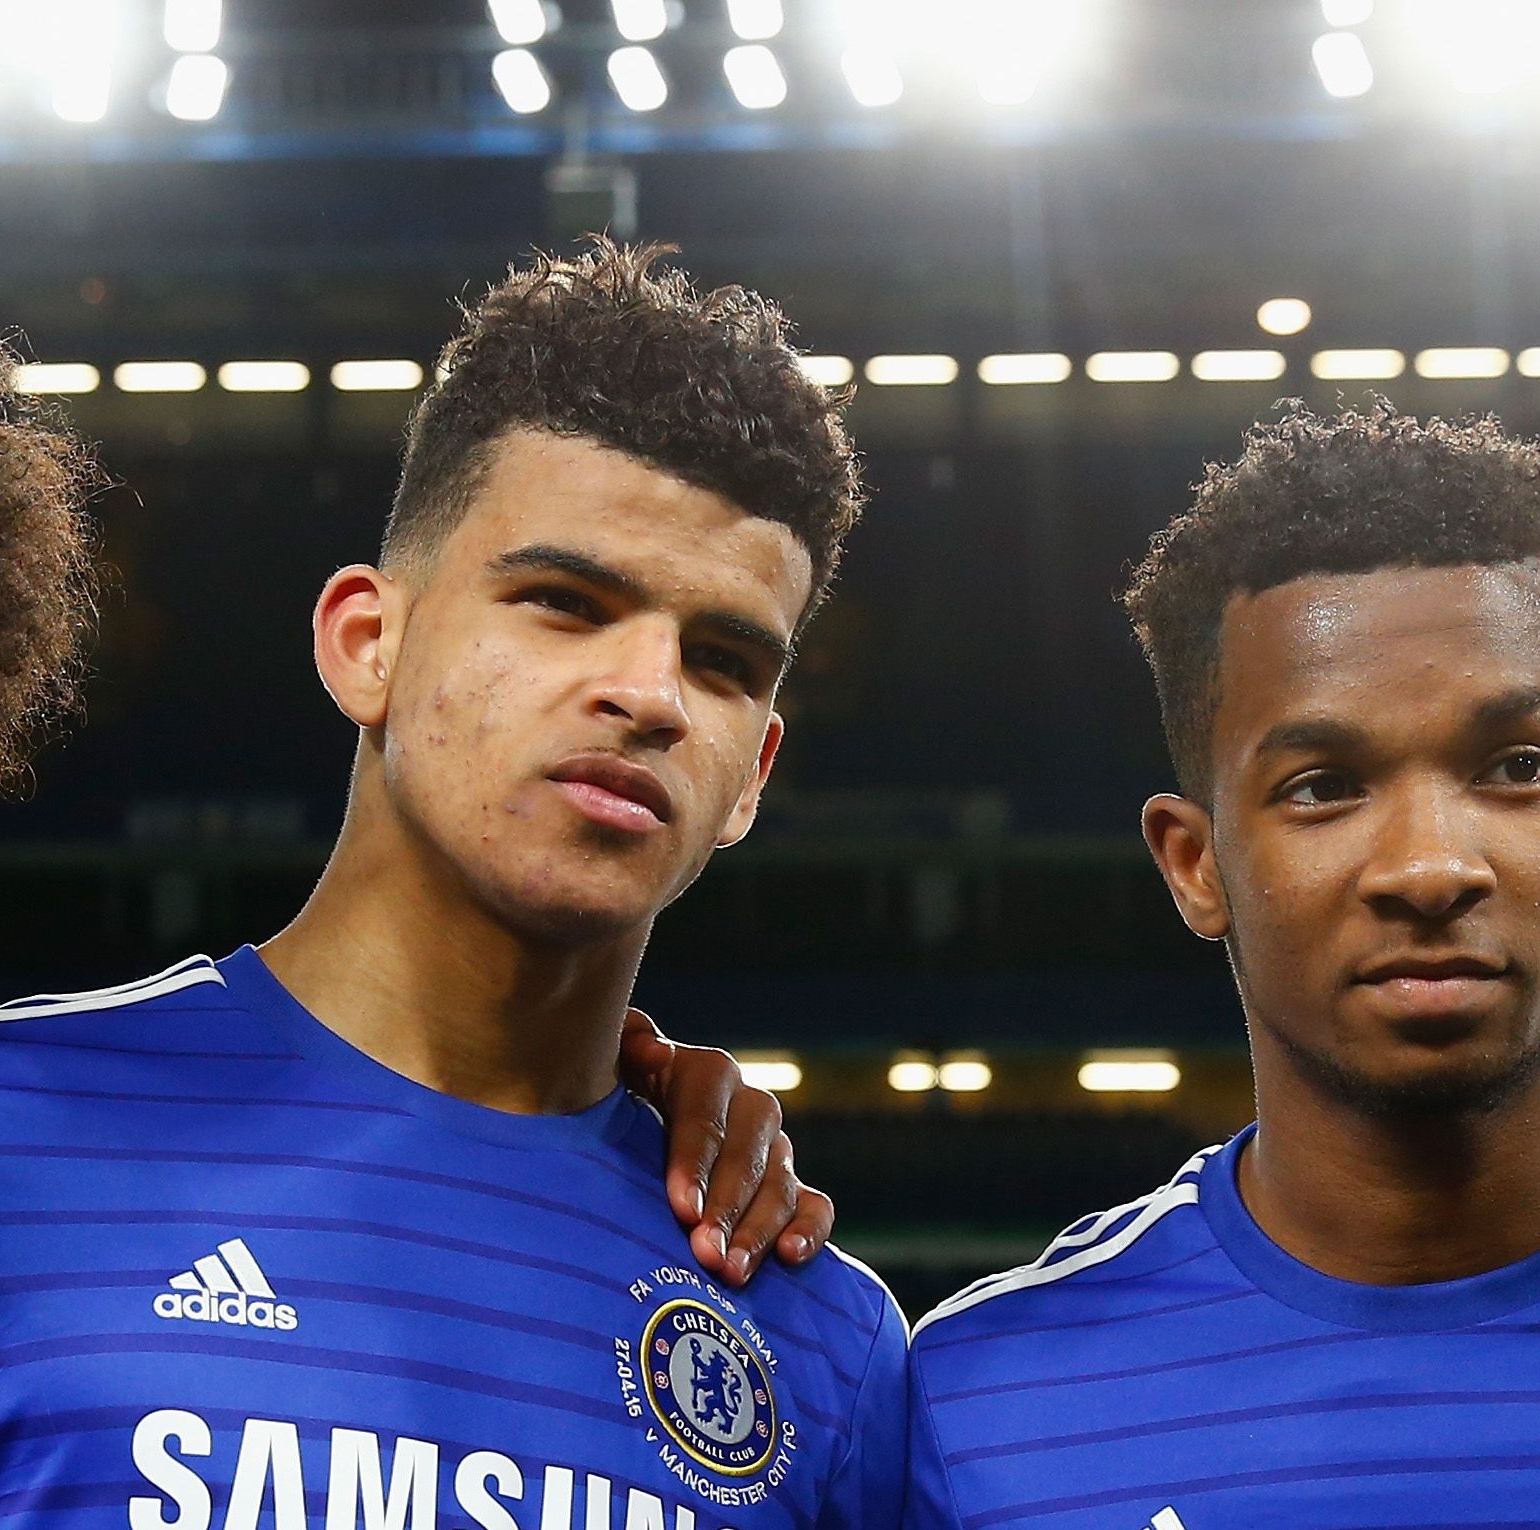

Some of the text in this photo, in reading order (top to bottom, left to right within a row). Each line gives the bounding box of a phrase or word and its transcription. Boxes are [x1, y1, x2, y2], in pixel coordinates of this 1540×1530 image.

[152, 1287, 299, 1331] adidas
[629, 1266, 782, 1374] FA YOUTH CUP FINAL
[672, 1312, 750, 1368] CHELSEA
[659, 1444, 768, 1507] MANCHESTER
[768, 1449, 793, 1487] CITY
[781, 1420, 798, 1450] FC
[669, 1411, 756, 1462] FOOTBALL CLUB
